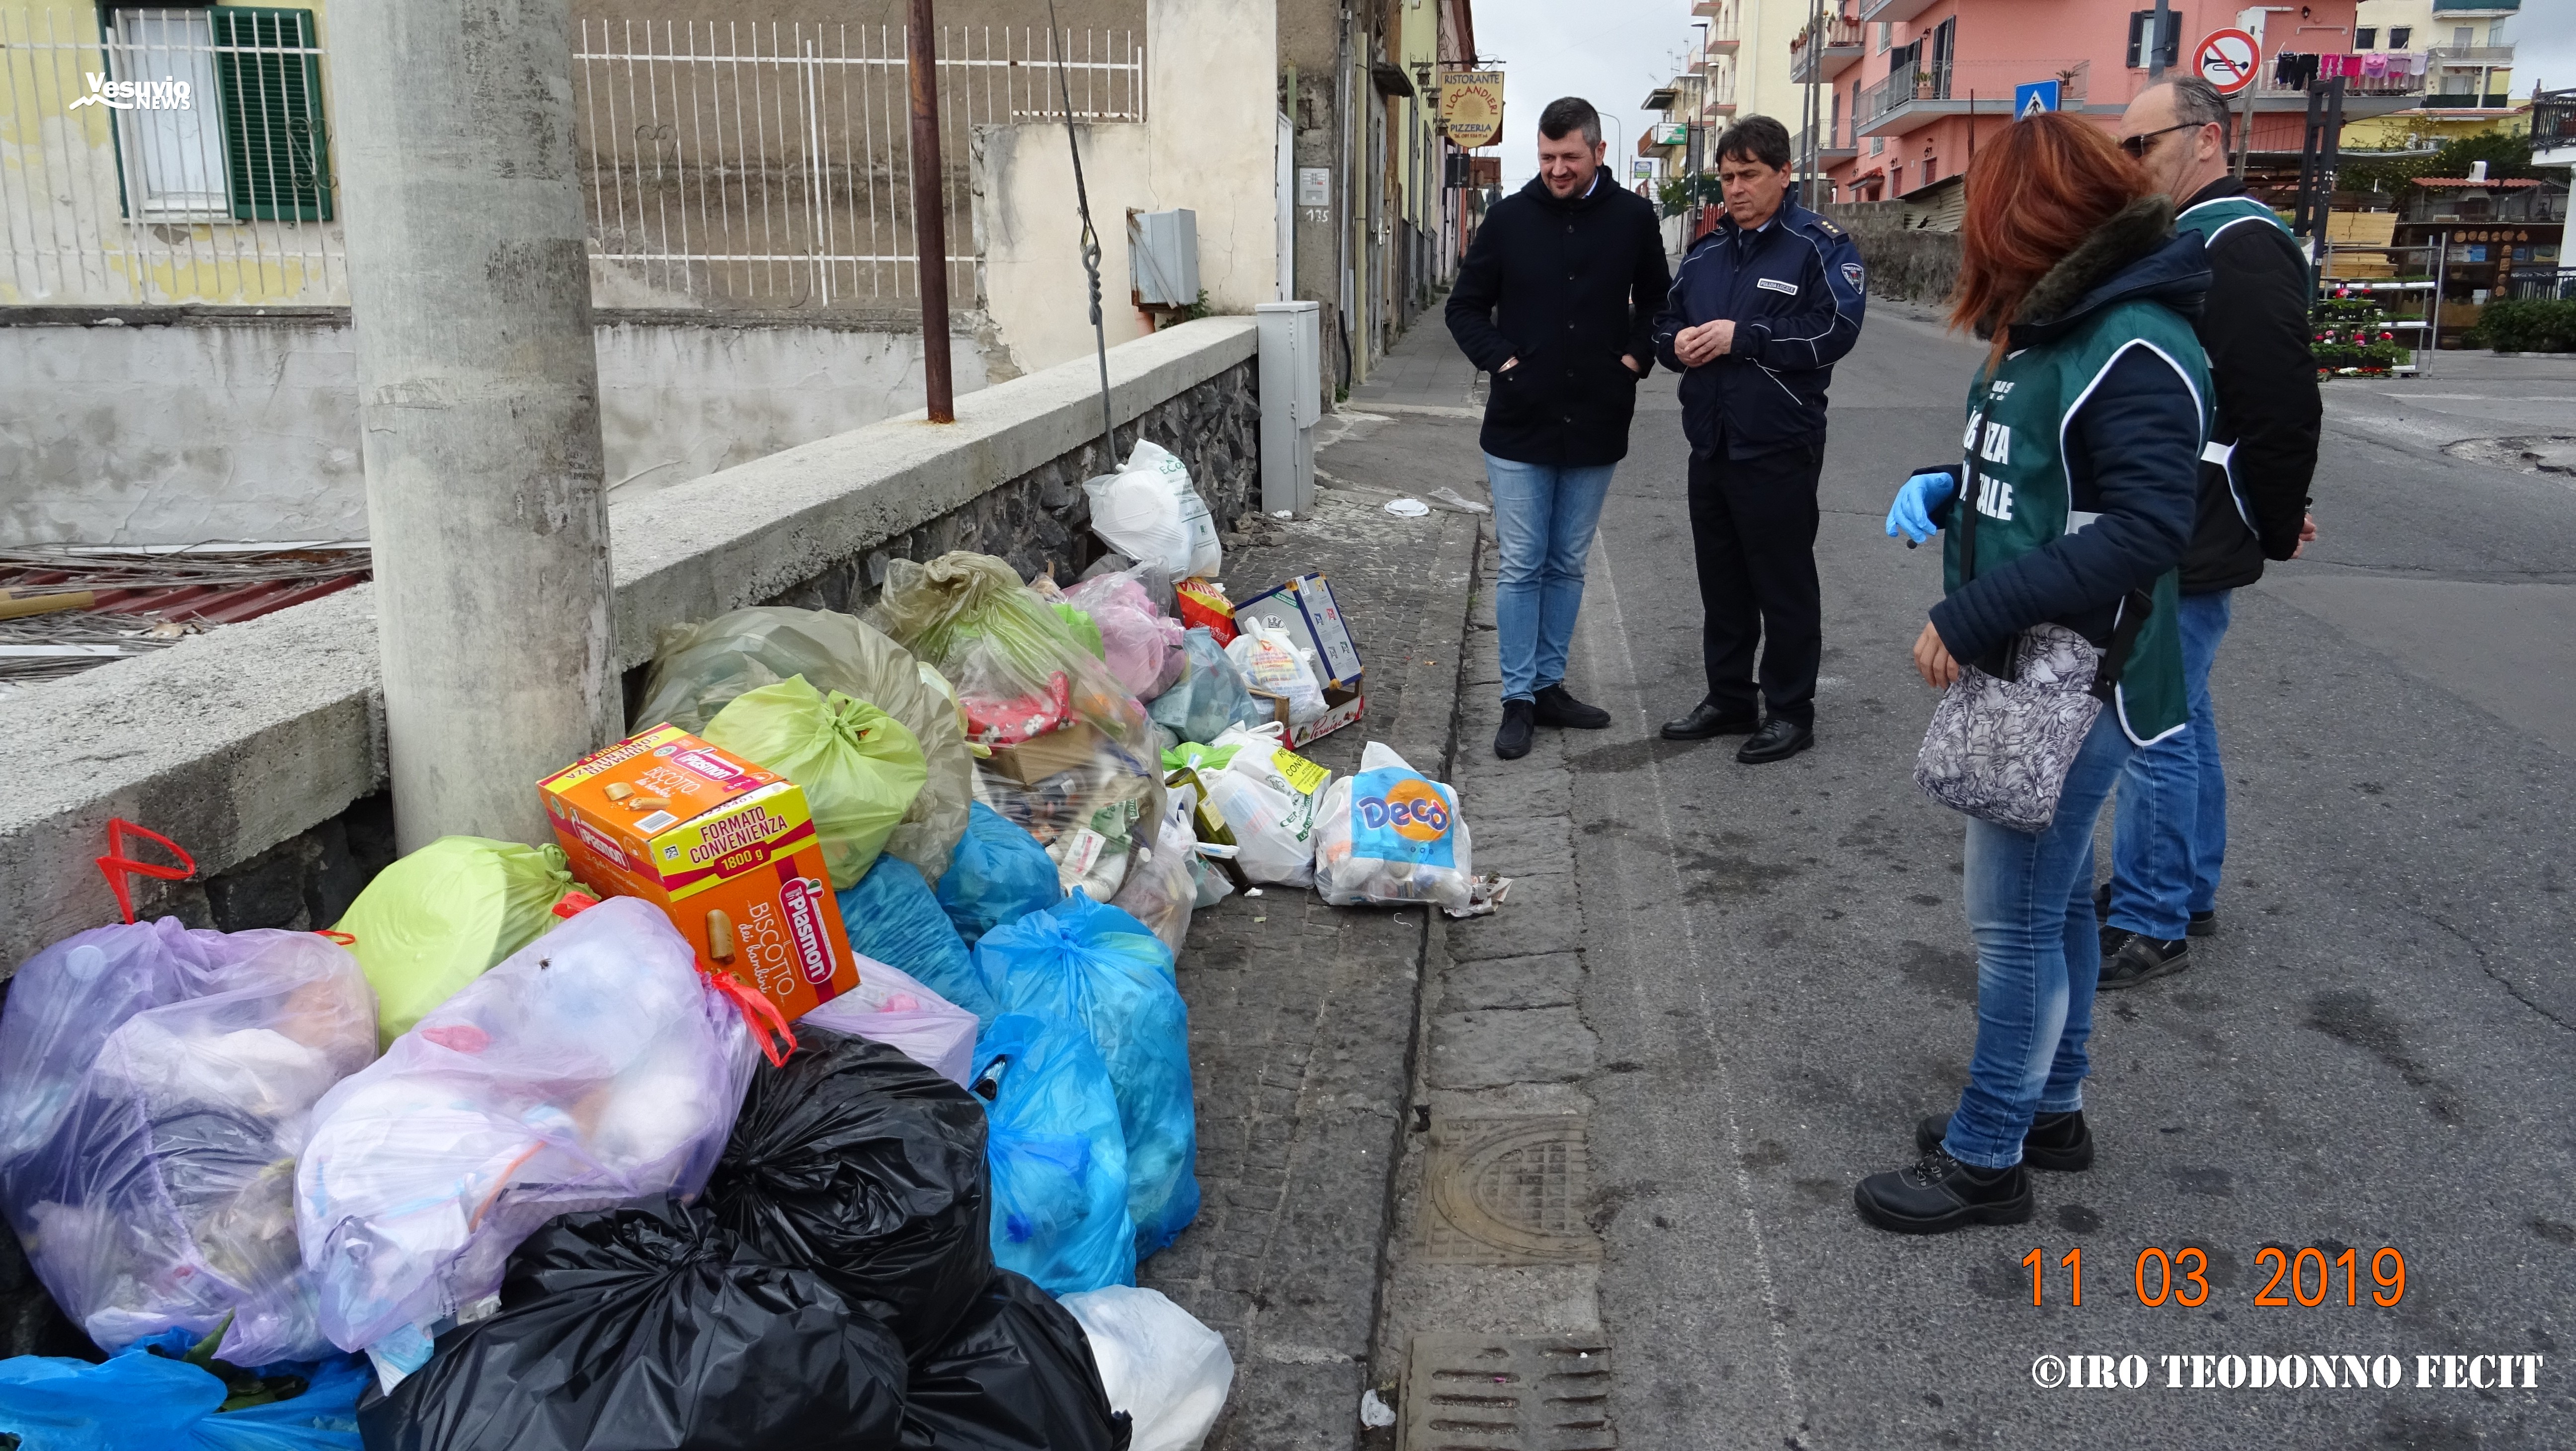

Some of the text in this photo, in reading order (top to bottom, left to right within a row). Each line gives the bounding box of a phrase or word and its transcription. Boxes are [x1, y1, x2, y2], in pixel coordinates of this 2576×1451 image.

[1445, 75, 1500, 84] RISTORANTE
[1446, 85, 1498, 115] LOCANDIERI
[1776, 284, 1794, 292] LOCALE
[565, 735, 660, 780] CONVENIENZA
[588, 745, 652, 775] FORMATO
[595, 744, 626, 758] 1800
[644, 766, 701, 793] BISCOTTO
[684, 754, 733, 779] Plasmon
[689, 814, 788, 864] CONVENIENZA
[700, 806, 766, 842] FORMATO
[721, 848, 763, 871] 1800 g
[749, 902, 795, 995] BISCOTTO
[788, 894, 825, 978] Plasmon
[738, 924, 771, 993] dei bambini
